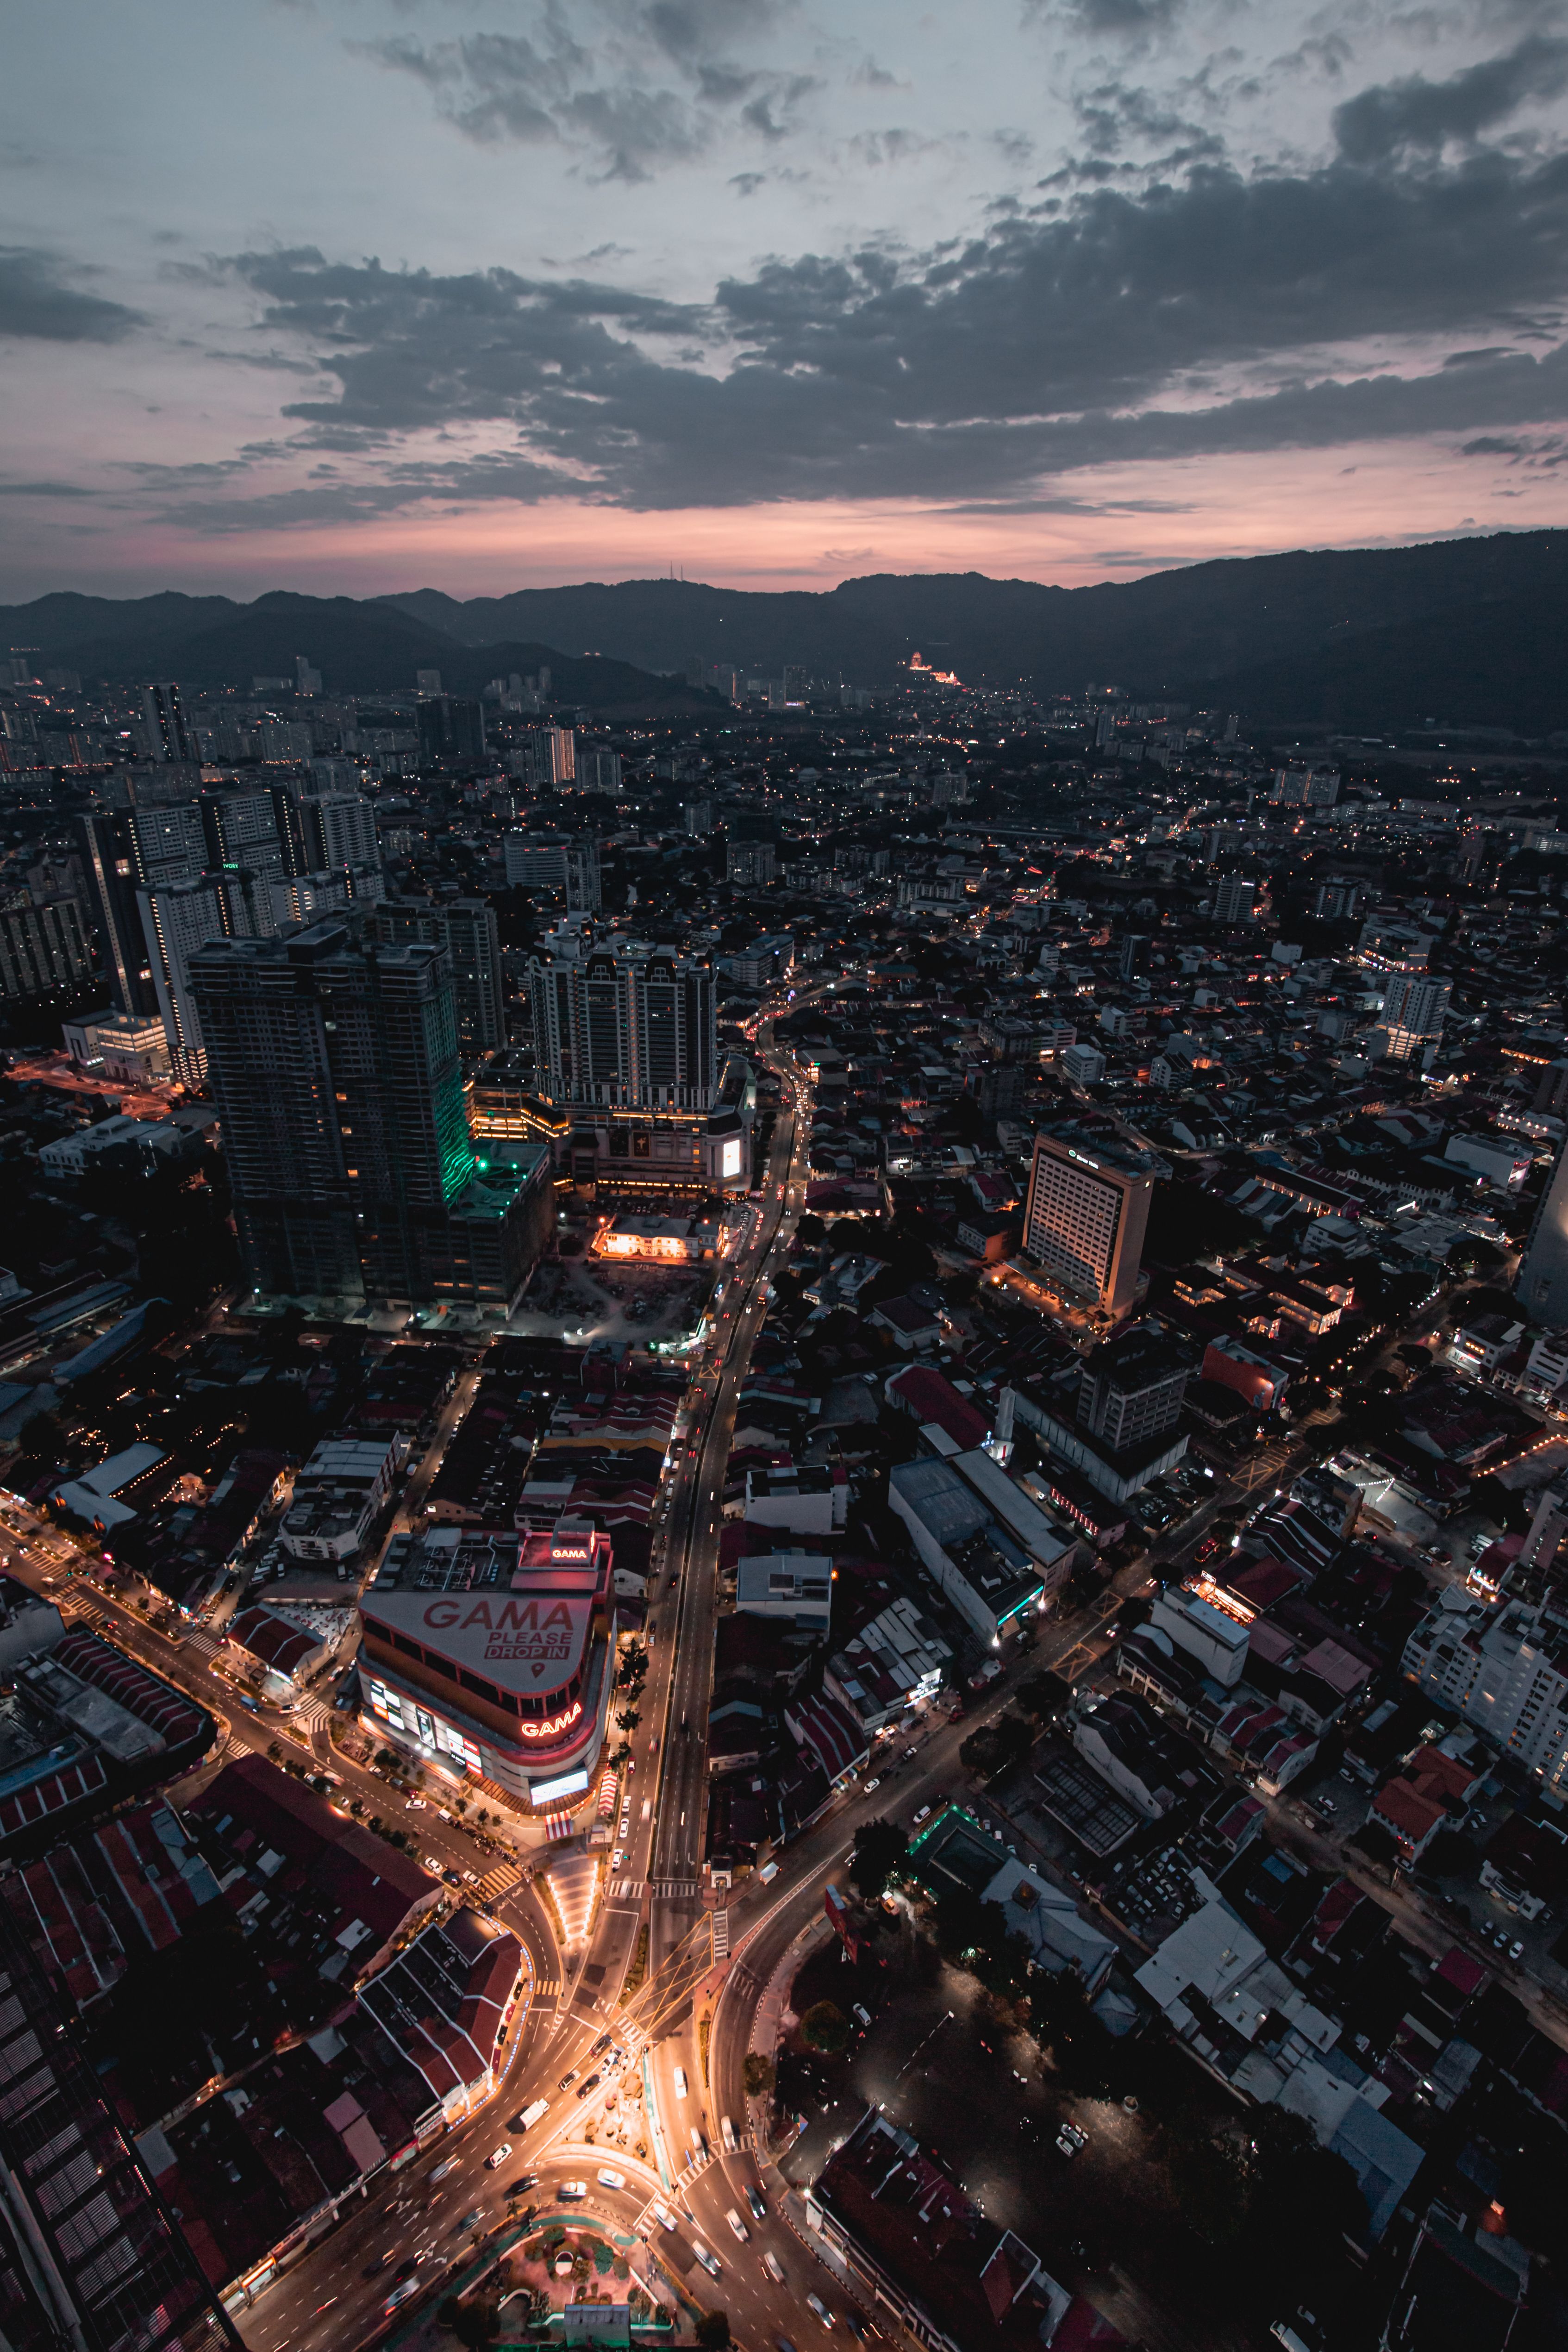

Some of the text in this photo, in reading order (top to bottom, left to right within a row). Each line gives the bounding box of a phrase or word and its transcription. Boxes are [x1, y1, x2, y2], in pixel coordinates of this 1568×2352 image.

[552, 1550, 587, 1558] GAMA
[423, 1601, 574, 1630] GAMA
[488, 1632, 574, 1644] PLEASE
[487, 1647, 566, 1658] DROP IN
[521, 1702, 581, 1737] GAMA
